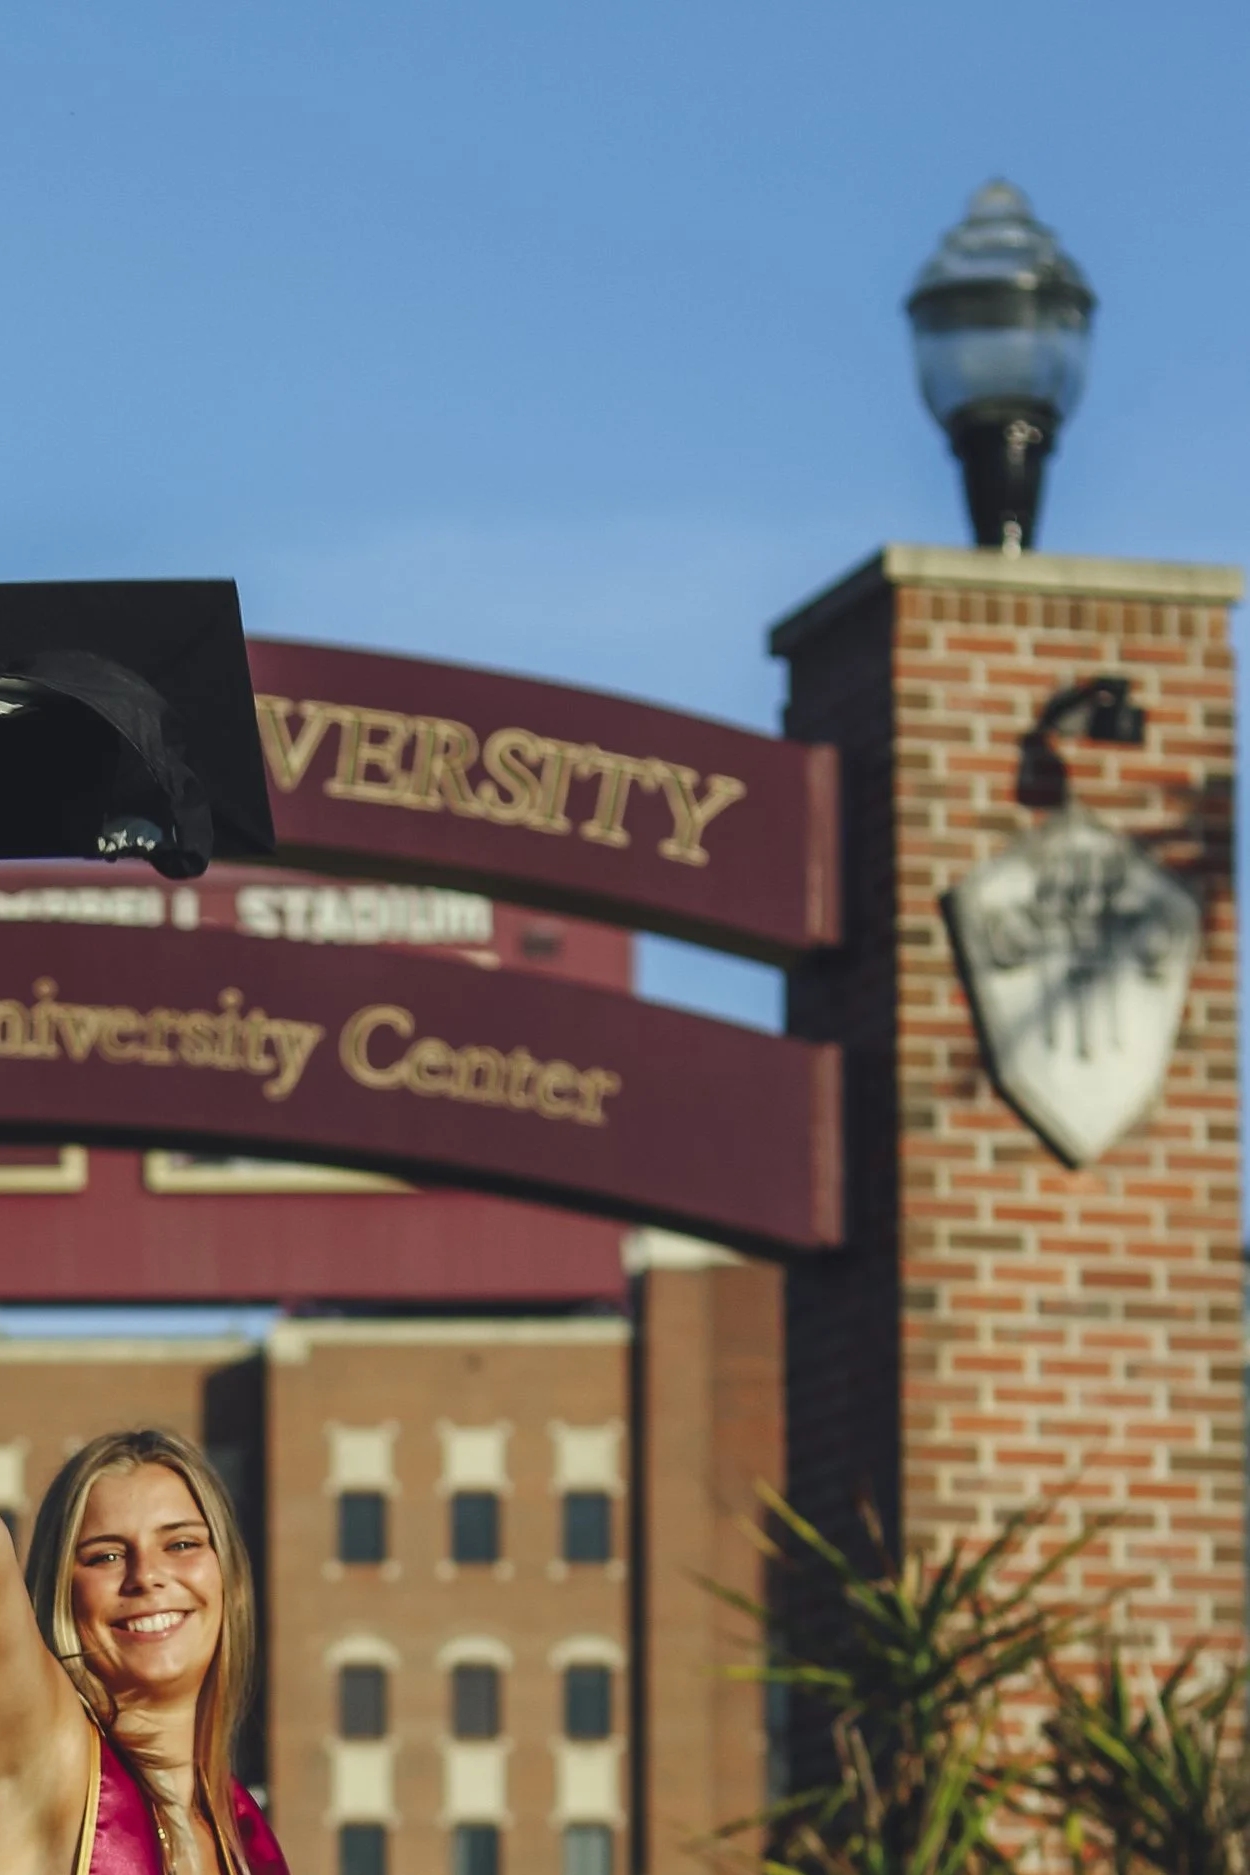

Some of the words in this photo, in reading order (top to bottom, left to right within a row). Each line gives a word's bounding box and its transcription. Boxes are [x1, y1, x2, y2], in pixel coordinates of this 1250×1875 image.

[254, 694, 745, 865] VERSITY
[236, 884, 493, 945] STADIUM
[340, 1006, 620, 1124] Center
